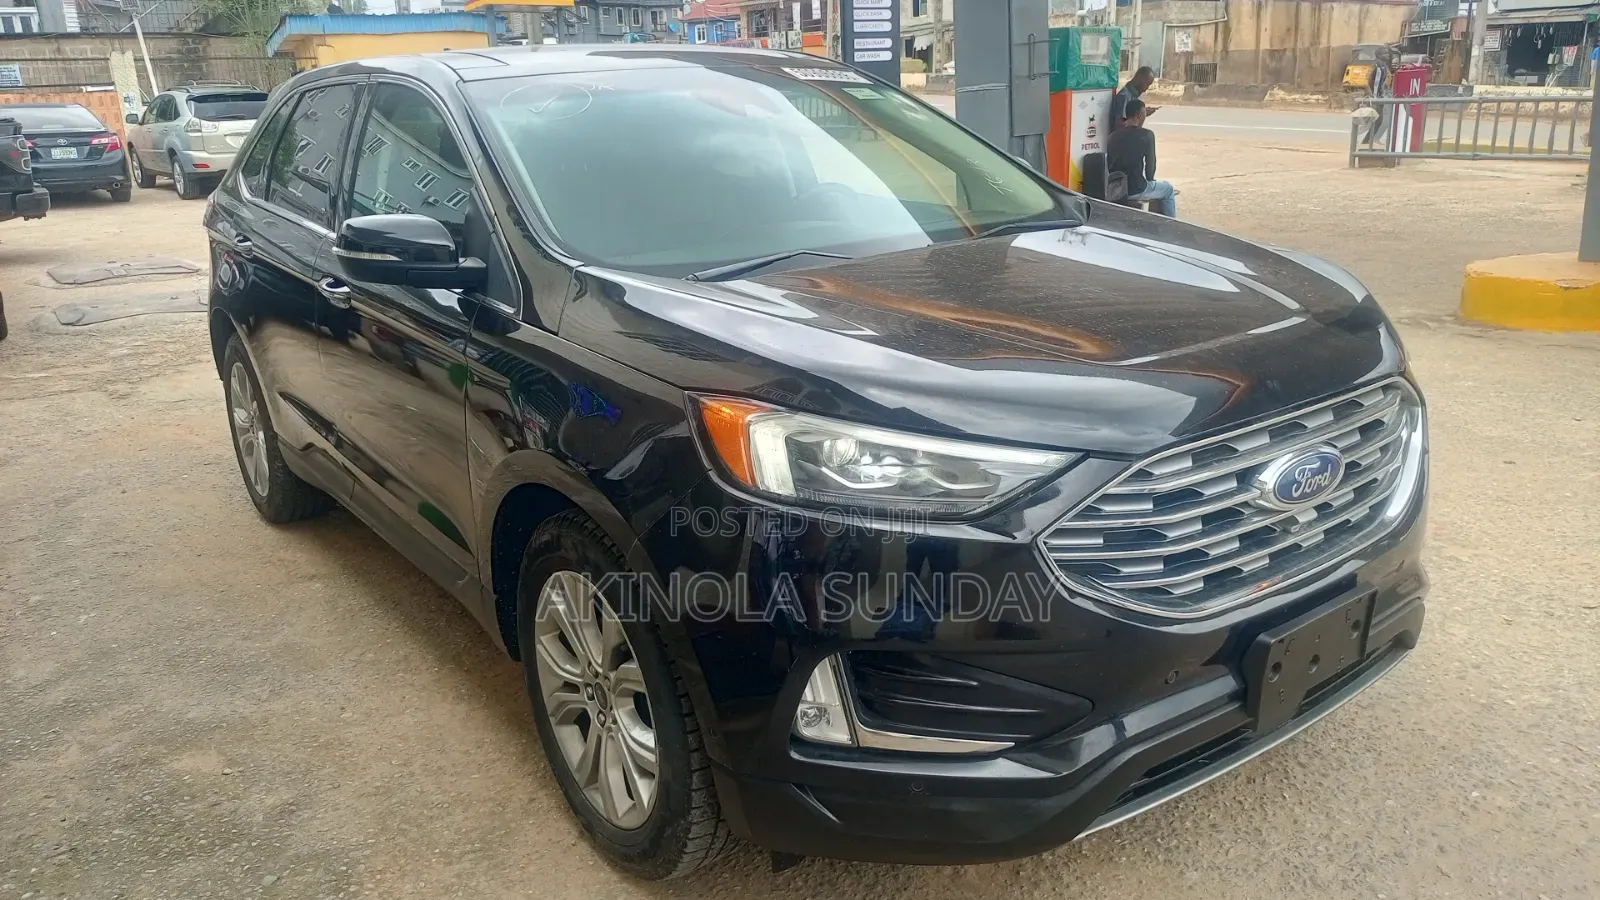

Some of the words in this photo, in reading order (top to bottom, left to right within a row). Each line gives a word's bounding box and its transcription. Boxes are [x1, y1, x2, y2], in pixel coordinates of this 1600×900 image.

[1409, 78, 1421, 95] IN
[1081, 142, 1100, 151] PETROL
[1291, 461, 1332, 498] Ford
